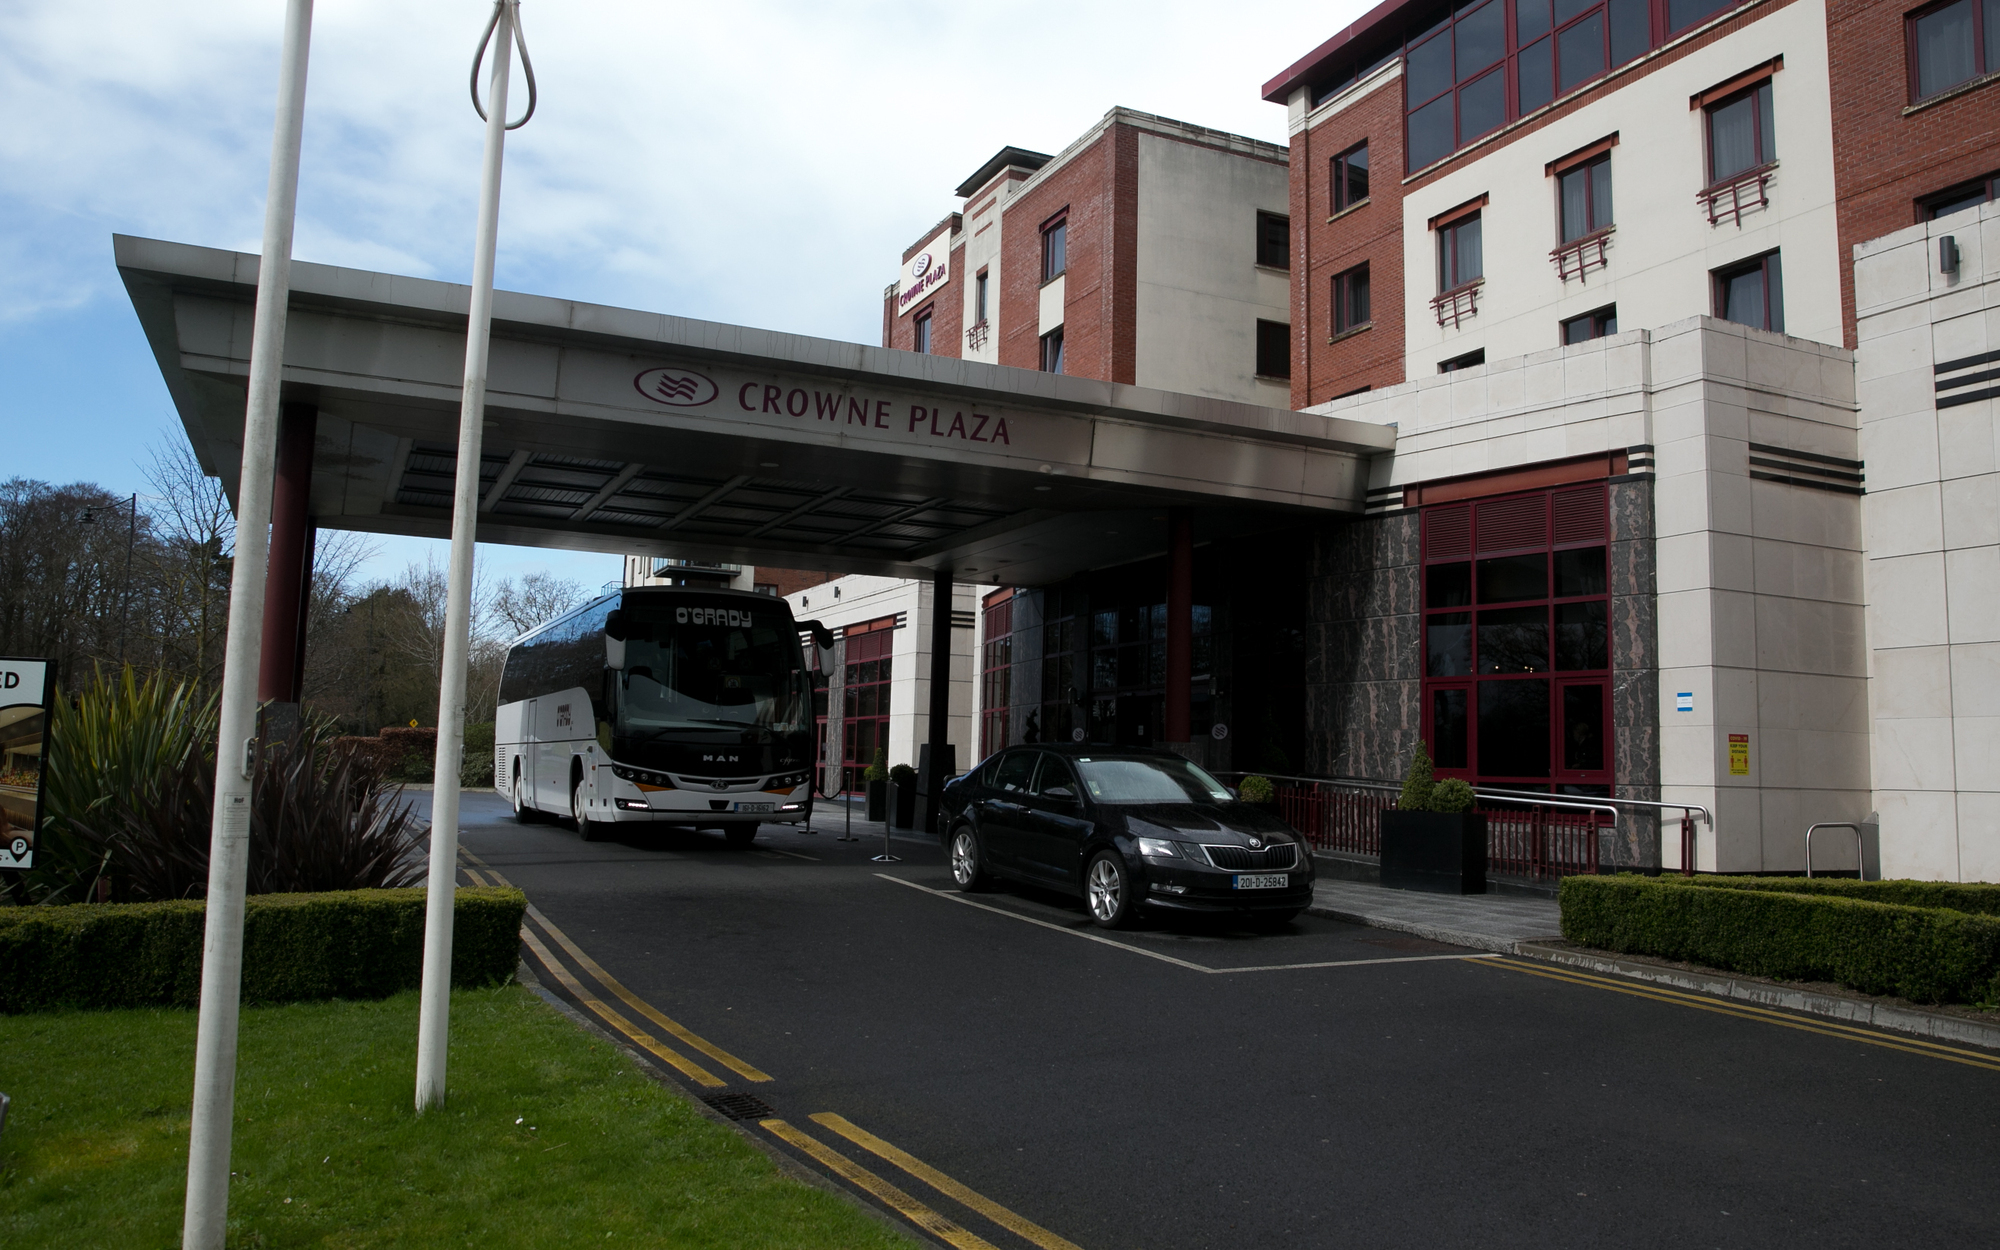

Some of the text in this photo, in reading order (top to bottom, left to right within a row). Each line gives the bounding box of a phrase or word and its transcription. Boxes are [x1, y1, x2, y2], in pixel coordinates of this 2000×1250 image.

[899, 263, 946, 308] CROWNE PLAZA
[738, 382, 1011, 445] CROWNE PLAZA
[676, 606, 752, 628] O'GRADY
[0, 671, 20, 689] D
[702, 754, 739, 762] MAN
[16, 841, 24, 851] P
[1240, 876, 1286, 888] 201-D-25842
